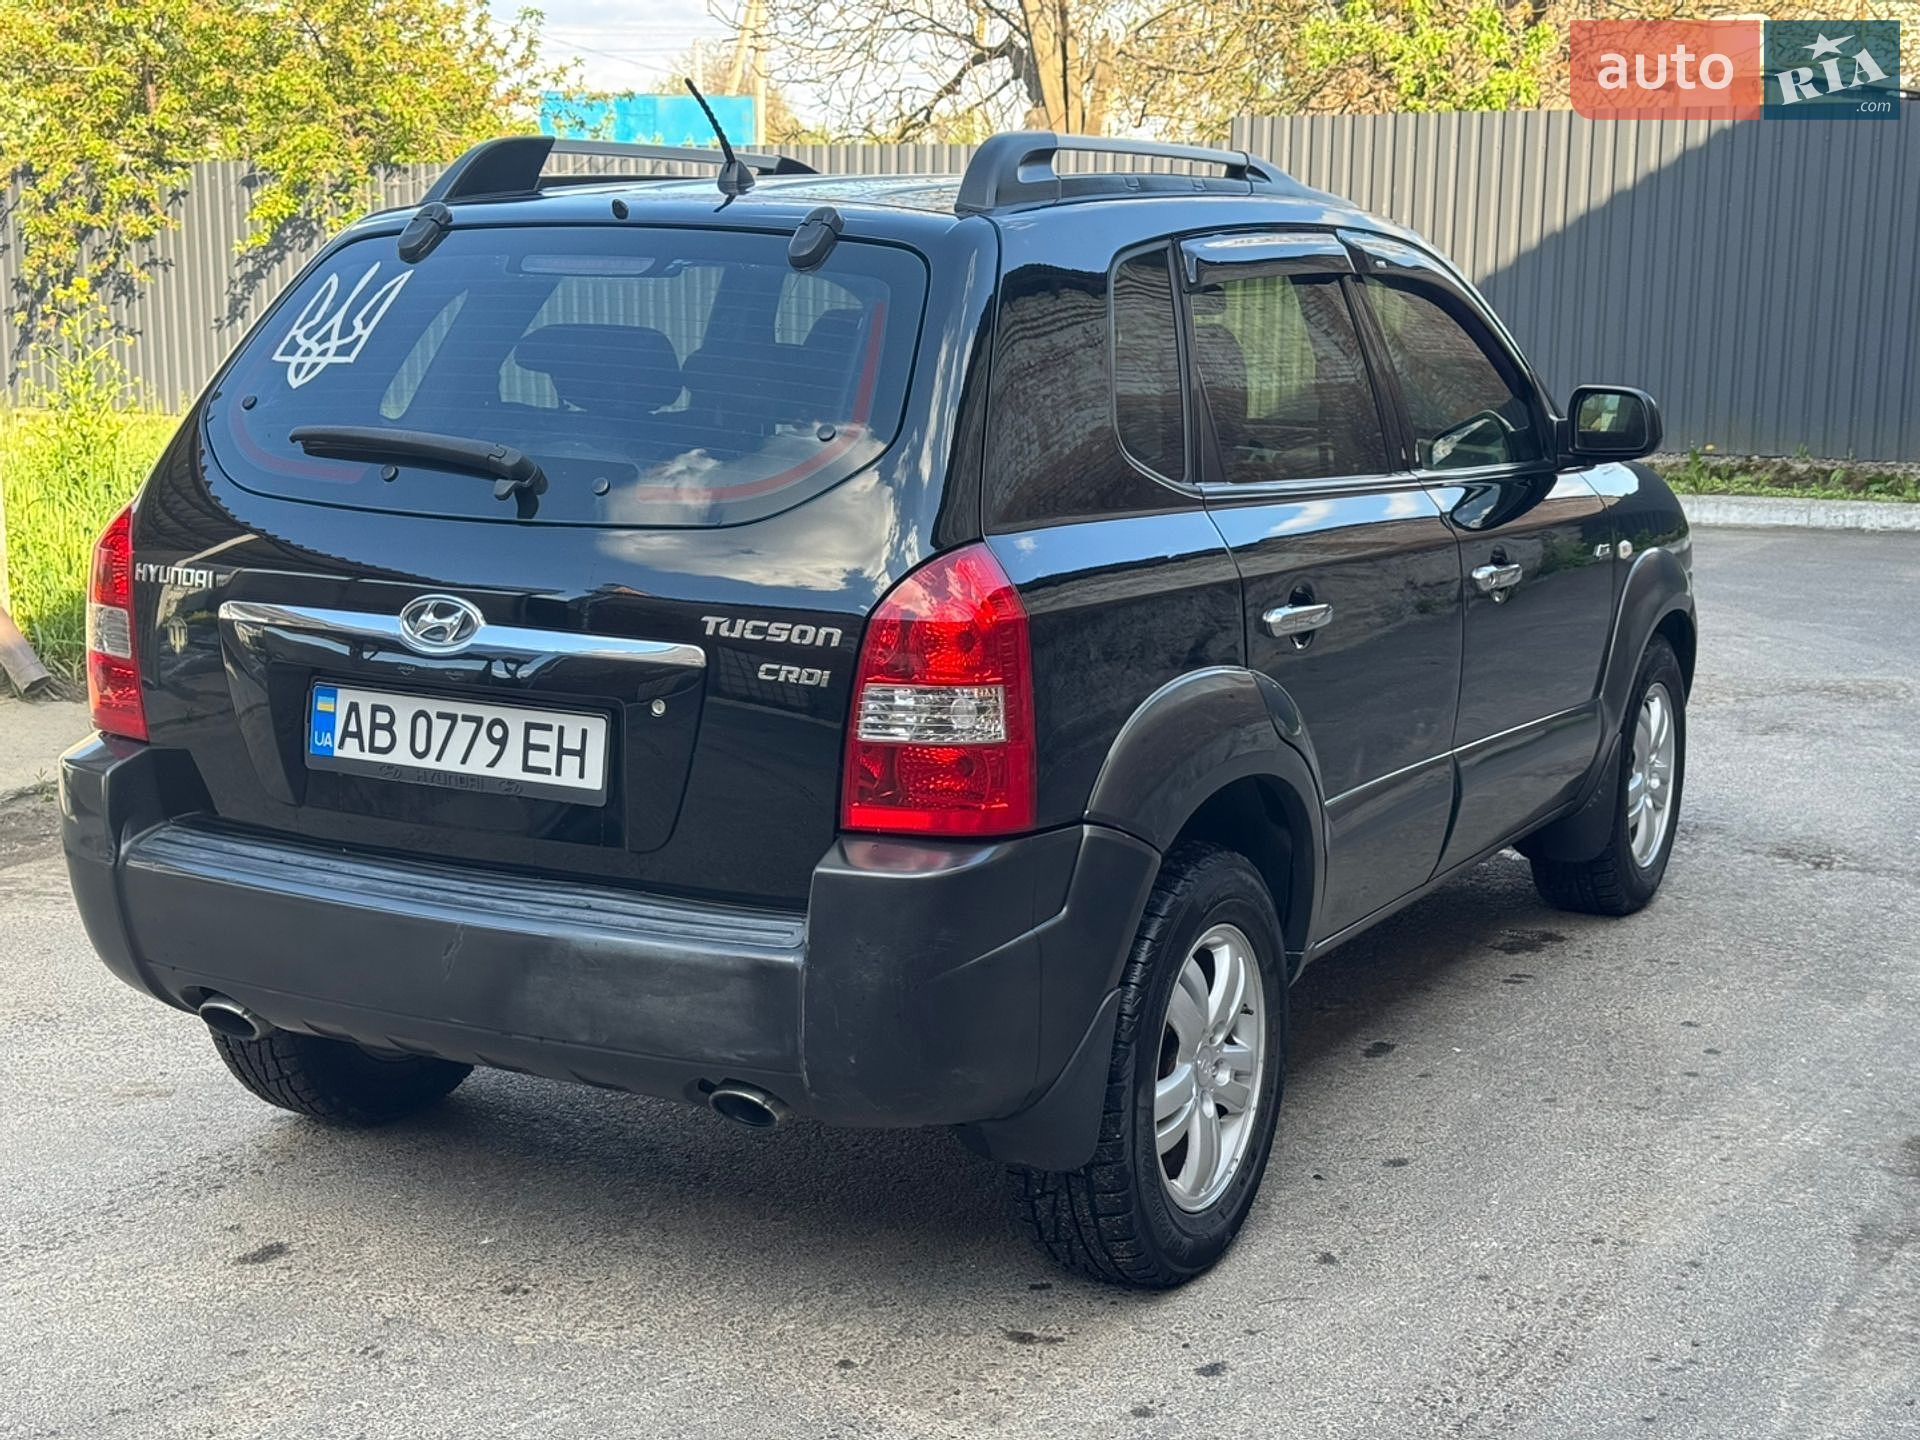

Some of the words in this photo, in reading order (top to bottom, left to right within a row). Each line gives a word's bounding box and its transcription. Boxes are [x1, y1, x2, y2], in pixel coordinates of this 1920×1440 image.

[134, 563, 214, 589] HYUNDAI
[314, 731, 333, 747] UA
[338, 701, 397, 755] AB
[409, 709, 510, 768] 0779
[522, 721, 588, 779] EH
